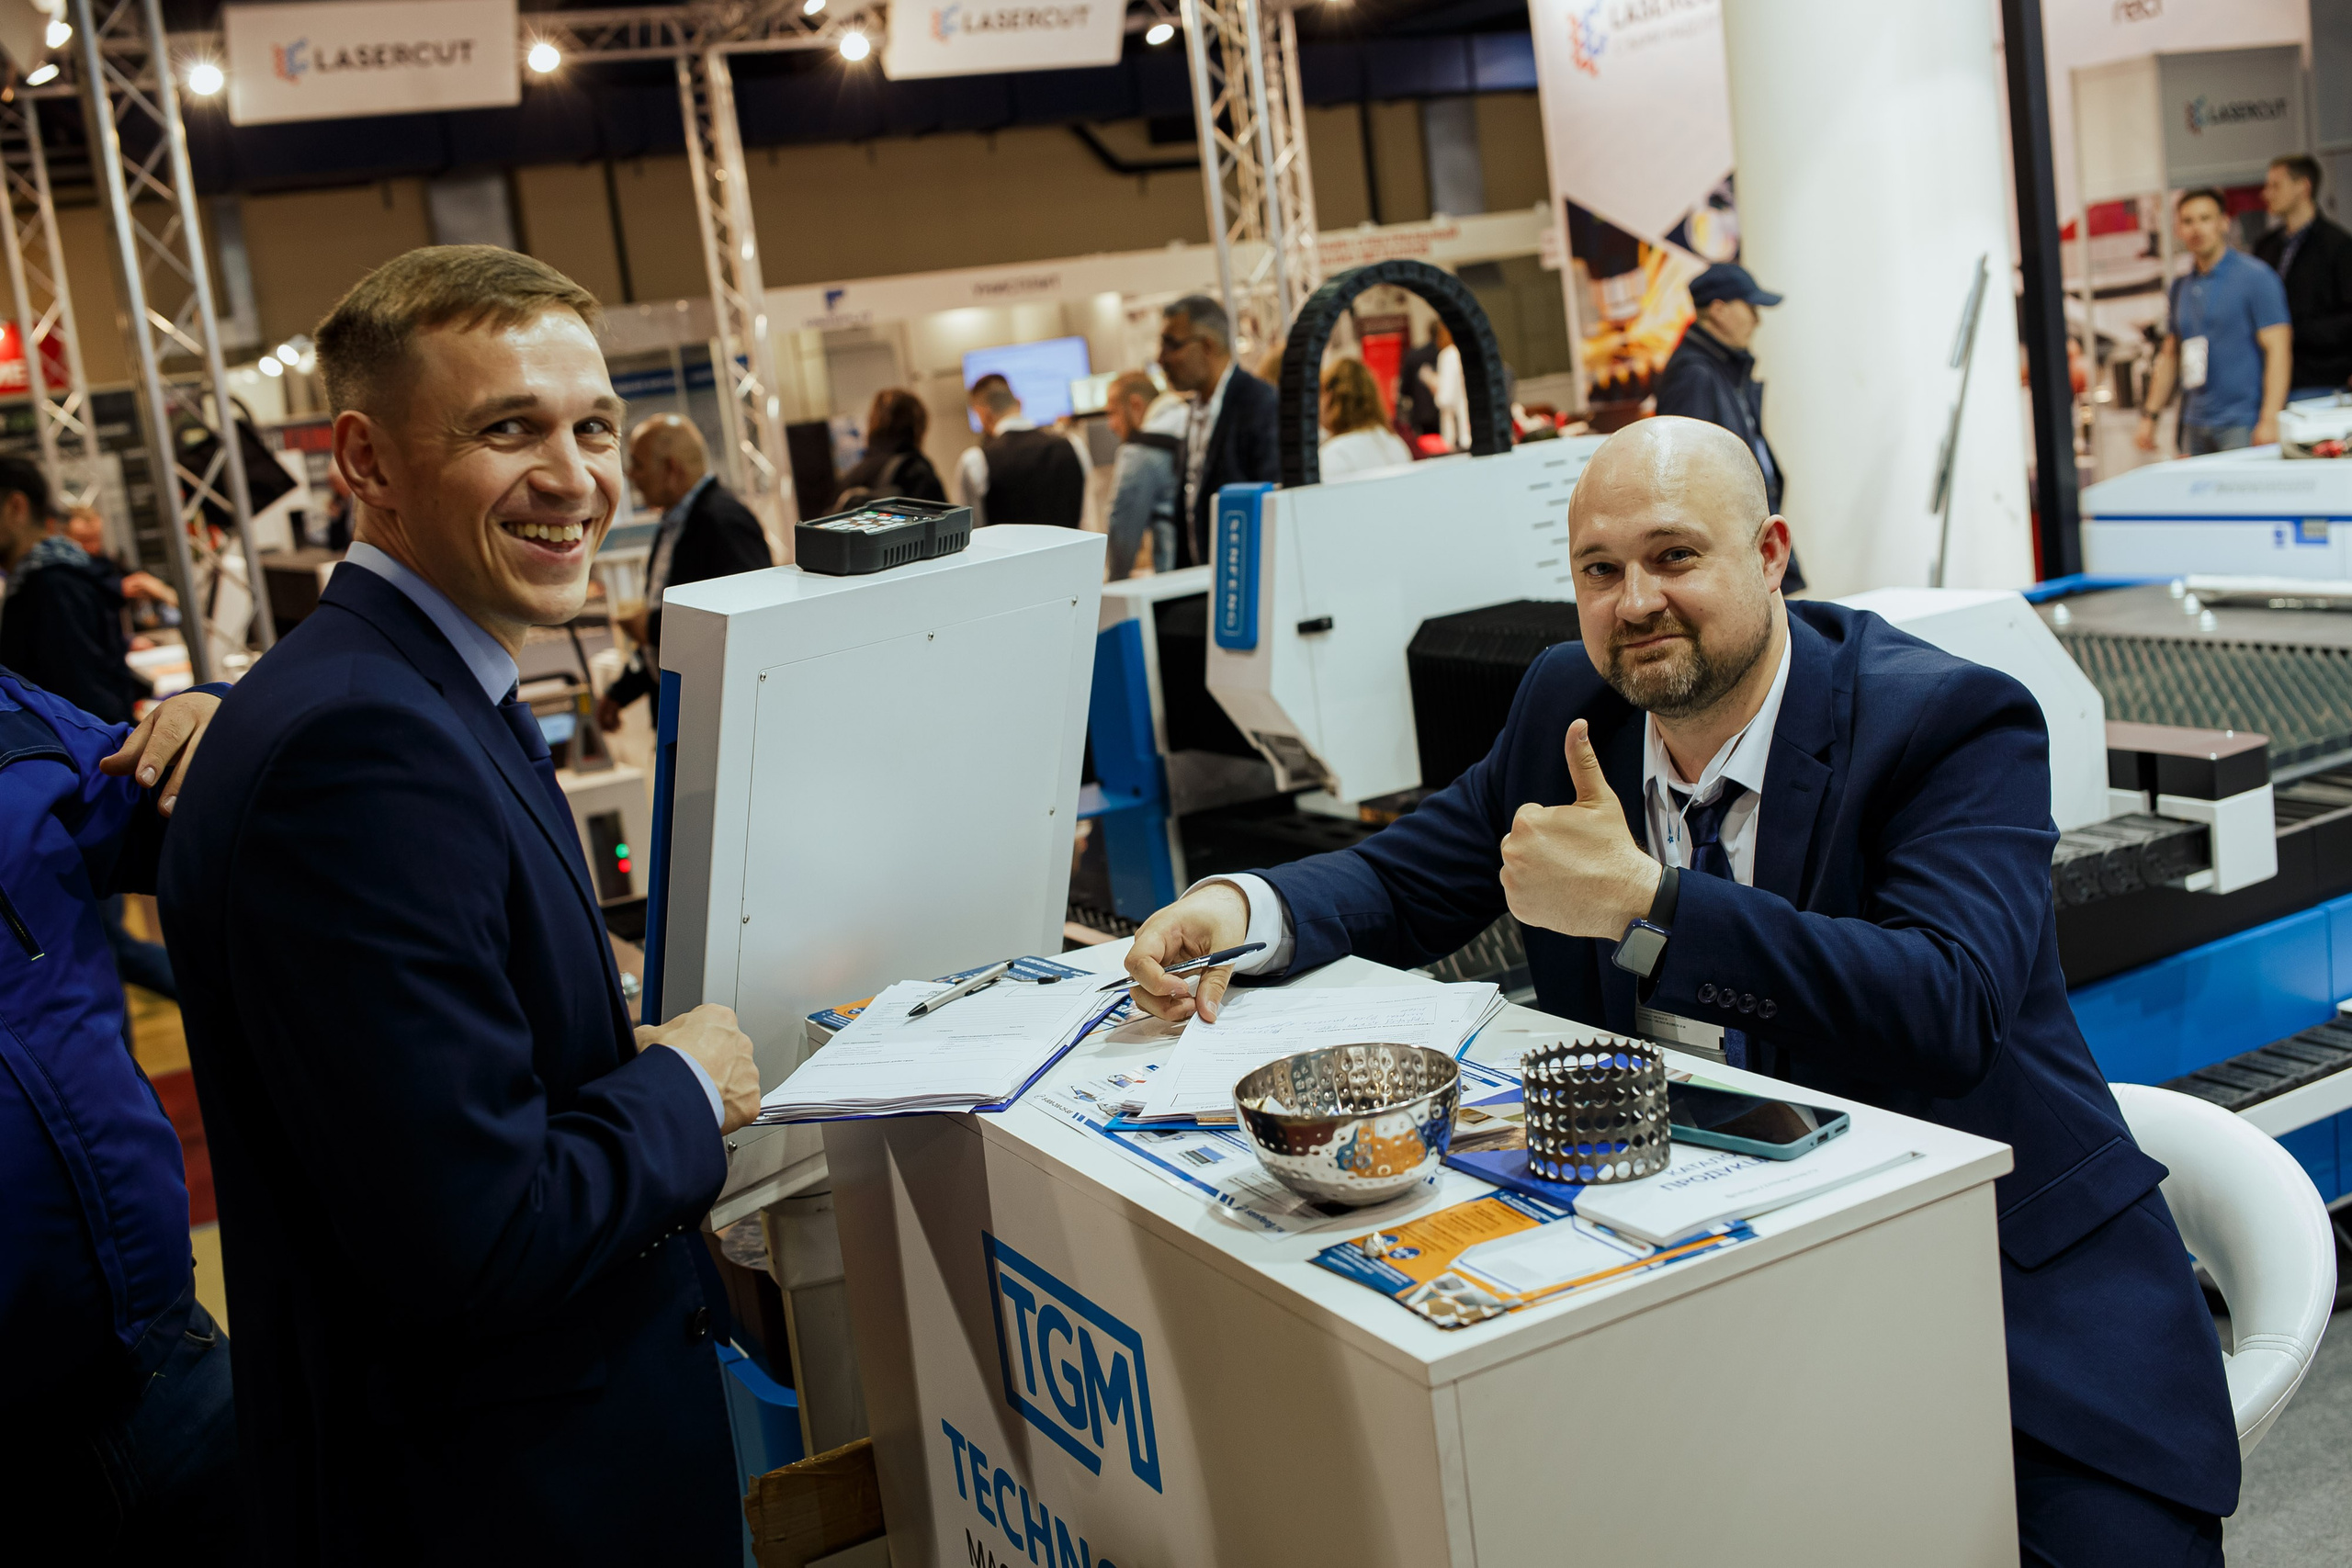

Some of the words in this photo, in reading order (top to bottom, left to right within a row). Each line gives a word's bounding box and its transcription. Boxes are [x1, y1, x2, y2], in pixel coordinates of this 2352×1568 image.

[961, 4, 1091, 34] LASERCUT
[314, 38, 475, 73] LASERCUT
[1659, 1156, 1770, 1191] ПРОДУКЦ
[1665, 1153, 1738, 1176] КАТАЛО
[1000, 1271, 1128, 1450] TGM
[941, 1417, 1119, 1568] TECHN
